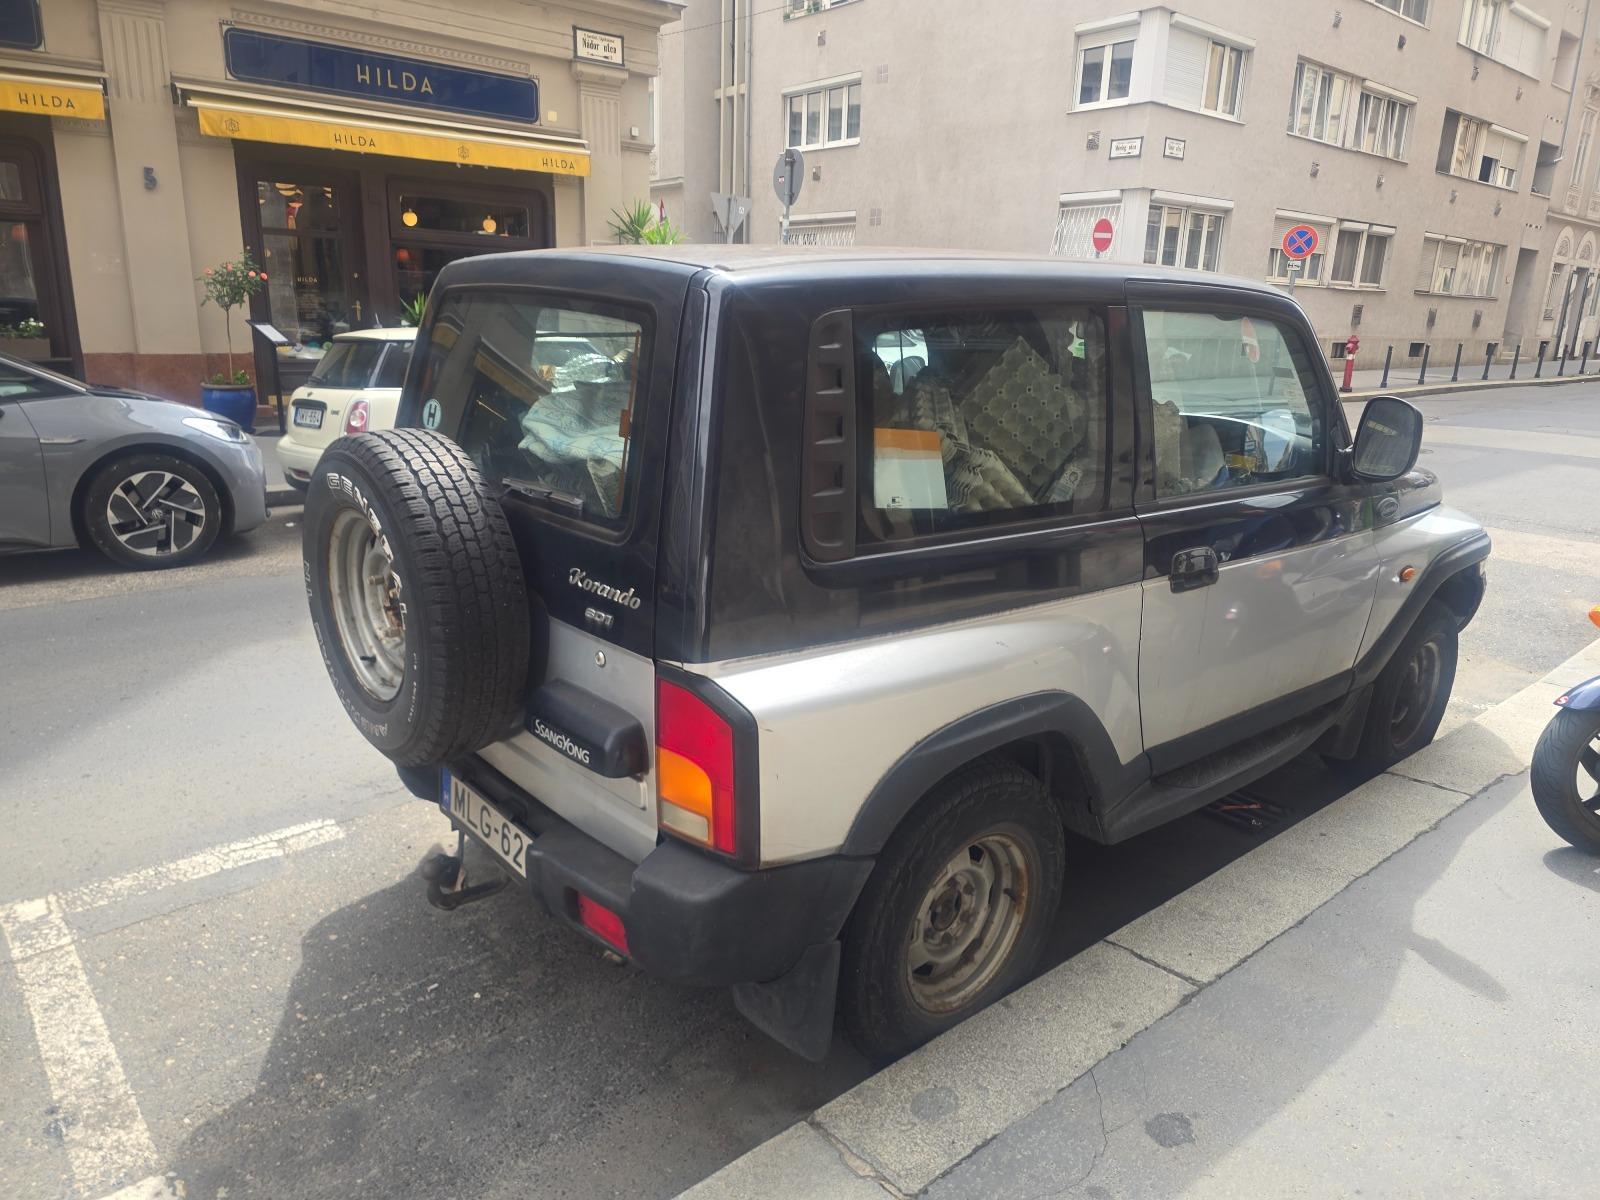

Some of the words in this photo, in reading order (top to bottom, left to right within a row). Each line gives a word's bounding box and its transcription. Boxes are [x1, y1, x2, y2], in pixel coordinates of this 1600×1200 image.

[582, 37, 600, 50] Nádor
[603, 42, 617, 54] utca
[356, 63, 434, 95] HILDA
[18, 92, 76, 110] HILDA
[333, 132, 377, 149] HILDA
[541, 157, 576, 170] HILDA
[143, 166, 157, 190] 5
[427, 403, 437, 427] H
[568, 567, 641, 610] Korando
